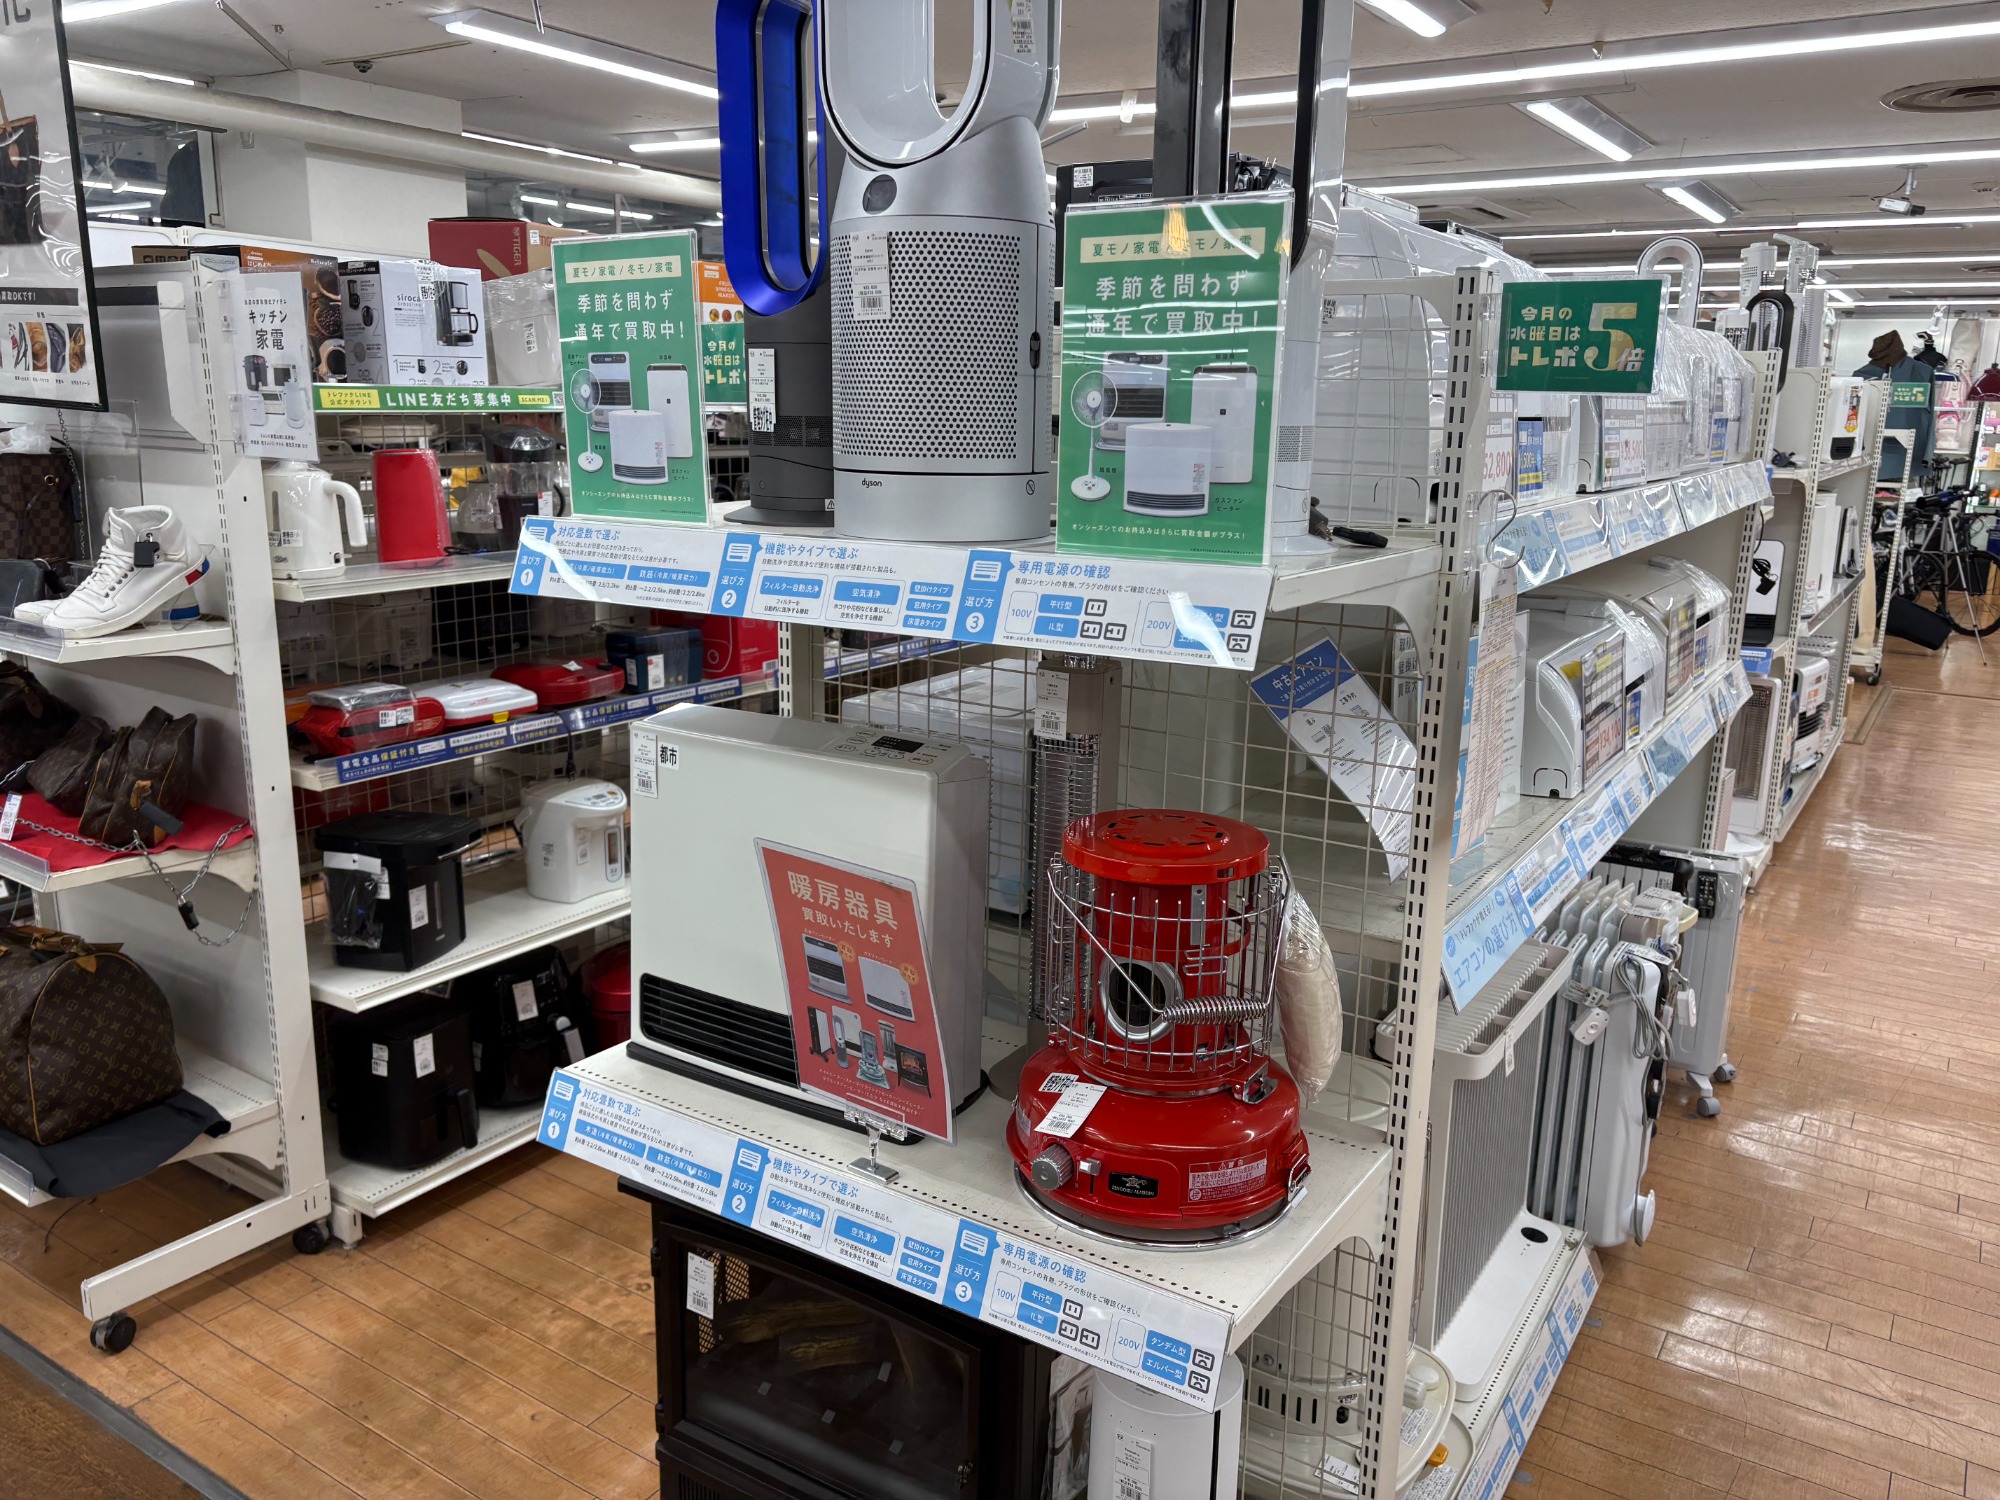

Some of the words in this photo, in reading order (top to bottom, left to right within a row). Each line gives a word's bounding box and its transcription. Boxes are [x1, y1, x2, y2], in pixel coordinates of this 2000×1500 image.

[513, 237, 522, 266] TIGER
[1096, 270, 1248, 301] 季節を問わず
[396, 293, 421, 302] siroca
[577, 288, 674, 313] 季節を問わず
[249, 310, 287, 324] キッチン
[1521, 306, 1573, 321] 今月の
[574, 320, 684, 341] 通年で買取中!
[1086, 309, 1259, 337] 通年で買取中!
[255, 328, 284, 351] 家電
[1510, 325, 1581, 341] 水曜日は
[707, 340, 736, 352] 今月の
[703, 354, 740, 366] 水曜日は
[1510, 344, 1580, 367] トレポ
[705, 368, 741, 385] トレポ
[386, 392, 512, 407] LINE友だち募集中
[861, 477, 883, 489] dyson
[557, 527, 621, 540] 対応畳数で選ぶ
[764, 542, 859, 559] 機能やタイプで選ぶ
[520, 555, 541, 566] 選び方
[1018, 560, 1110, 579] 専用電源の確認
[721, 575, 745, 586] 選び方
[764, 581, 819, 594] フィルター自動洗浄
[851, 588, 881, 599] 空気清浄
[914, 584, 950, 595] 壁掛けタイプ
[913, 601, 942, 611] 窓用タイプ
[964, 596, 994, 608] 選び方
[1049, 600, 1073, 610] 平行型
[1011, 608, 1033, 619] 100V
[907, 618, 943, 628] 床置きタイプ
[1147, 619, 1172, 630] 200V
[660, 744, 678, 767] 都市
[787, 871, 898, 930] 暖房器具
[802, 907, 894, 949] 買取いたします
[1454, 910, 1518, 989] エアコンの選び方
[583, 1088, 641, 1117] 対応畳数で選ぶ
[547, 1108, 567, 1122] 選び方
[732, 1178, 754, 1194] 選び方
[772, 1158, 859, 1198] 機能やタイプで選ぶ
[771, 1196, 822, 1222] フィルター自動洗浄
[781, 1216, 803, 1230] フィルターを
[851, 1227, 878, 1243] 空気清浄
[907, 1240, 940, 1257] 壁掛けタイプ
[907, 1257, 934, 1272] 窓用タイプ
[1003, 1242, 1087, 1284] 専用電源の確認
[954, 1263, 981, 1282] 選び方
[900, 1272, 933, 1290] 床置きタイプ
[996, 1288, 1016, 1302] 100V
[1031, 1289, 1053, 1304] 平行型
[1118, 1336, 1141, 1351] 200V
[1151, 1336, 1187, 1358] タンデム型
[1145, 1358, 1183, 1380] エルバー型
